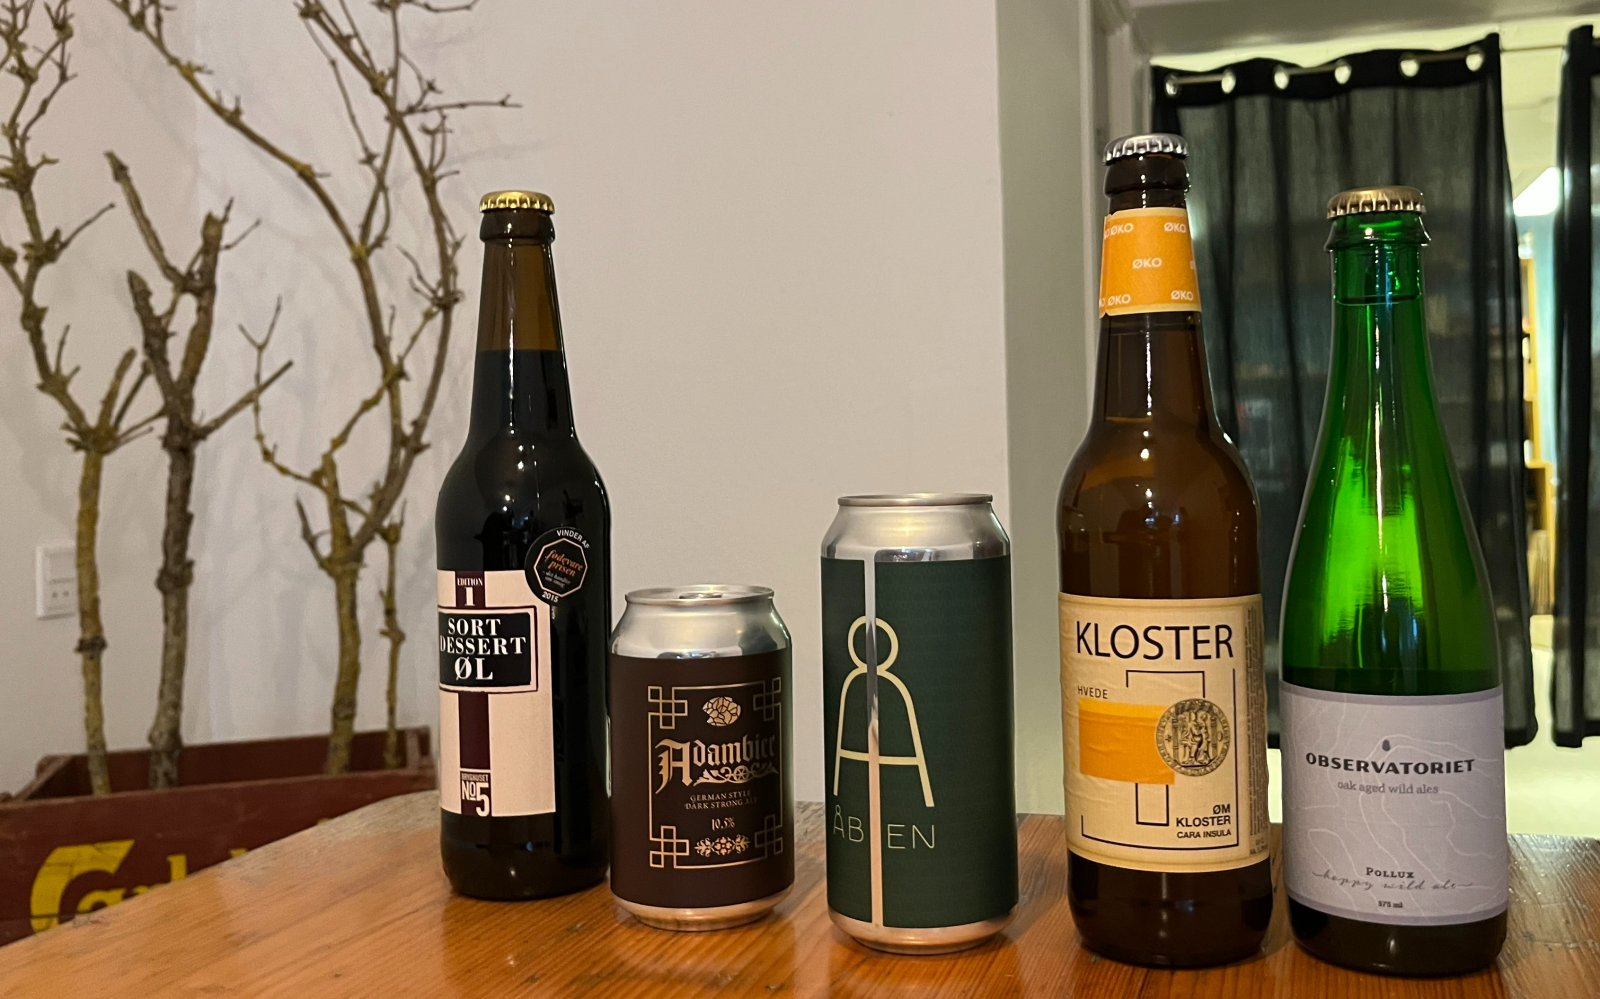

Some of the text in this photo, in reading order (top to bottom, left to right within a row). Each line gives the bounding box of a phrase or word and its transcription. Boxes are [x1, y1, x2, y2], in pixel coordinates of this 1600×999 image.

[1110, 223, 1134, 236] ØKO
[1163, 222, 1187, 233] ØKO
[1132, 257, 1162, 269] ØKO
[1108, 294, 1131, 306] ØKO
[1171, 290, 1193, 301] ØKO
[556, 529, 591, 549] VINDER AF
[547, 561, 576, 577] prisen
[457, 577, 483, 587] EDITION
[464, 586, 475, 607] 1
[541, 590, 559, 603] 2015
[447, 617, 501, 636] SORT
[440, 635, 527, 655] DESSERT
[1076, 620, 1234, 660] KLOSTER
[454, 656, 493, 681] ØL
[1077, 685, 1108, 699] HVEDE
[1306, 752, 1475, 775] OBSERVATORIET
[1337, 780, 1439, 794] oak aged wild ales
[689, 790, 751, 802] GERMAN STYLE
[684, 801, 709, 810] DARK
[710, 799, 743, 809] STRONG
[1212, 803, 1231, 815] ØM
[711, 816, 736, 831] 10.5%
[1176, 815, 1231, 828] KLOSTER
[1176, 829, 1232, 839] CARA INSULA
[1383, 879, 1425, 890] wild
